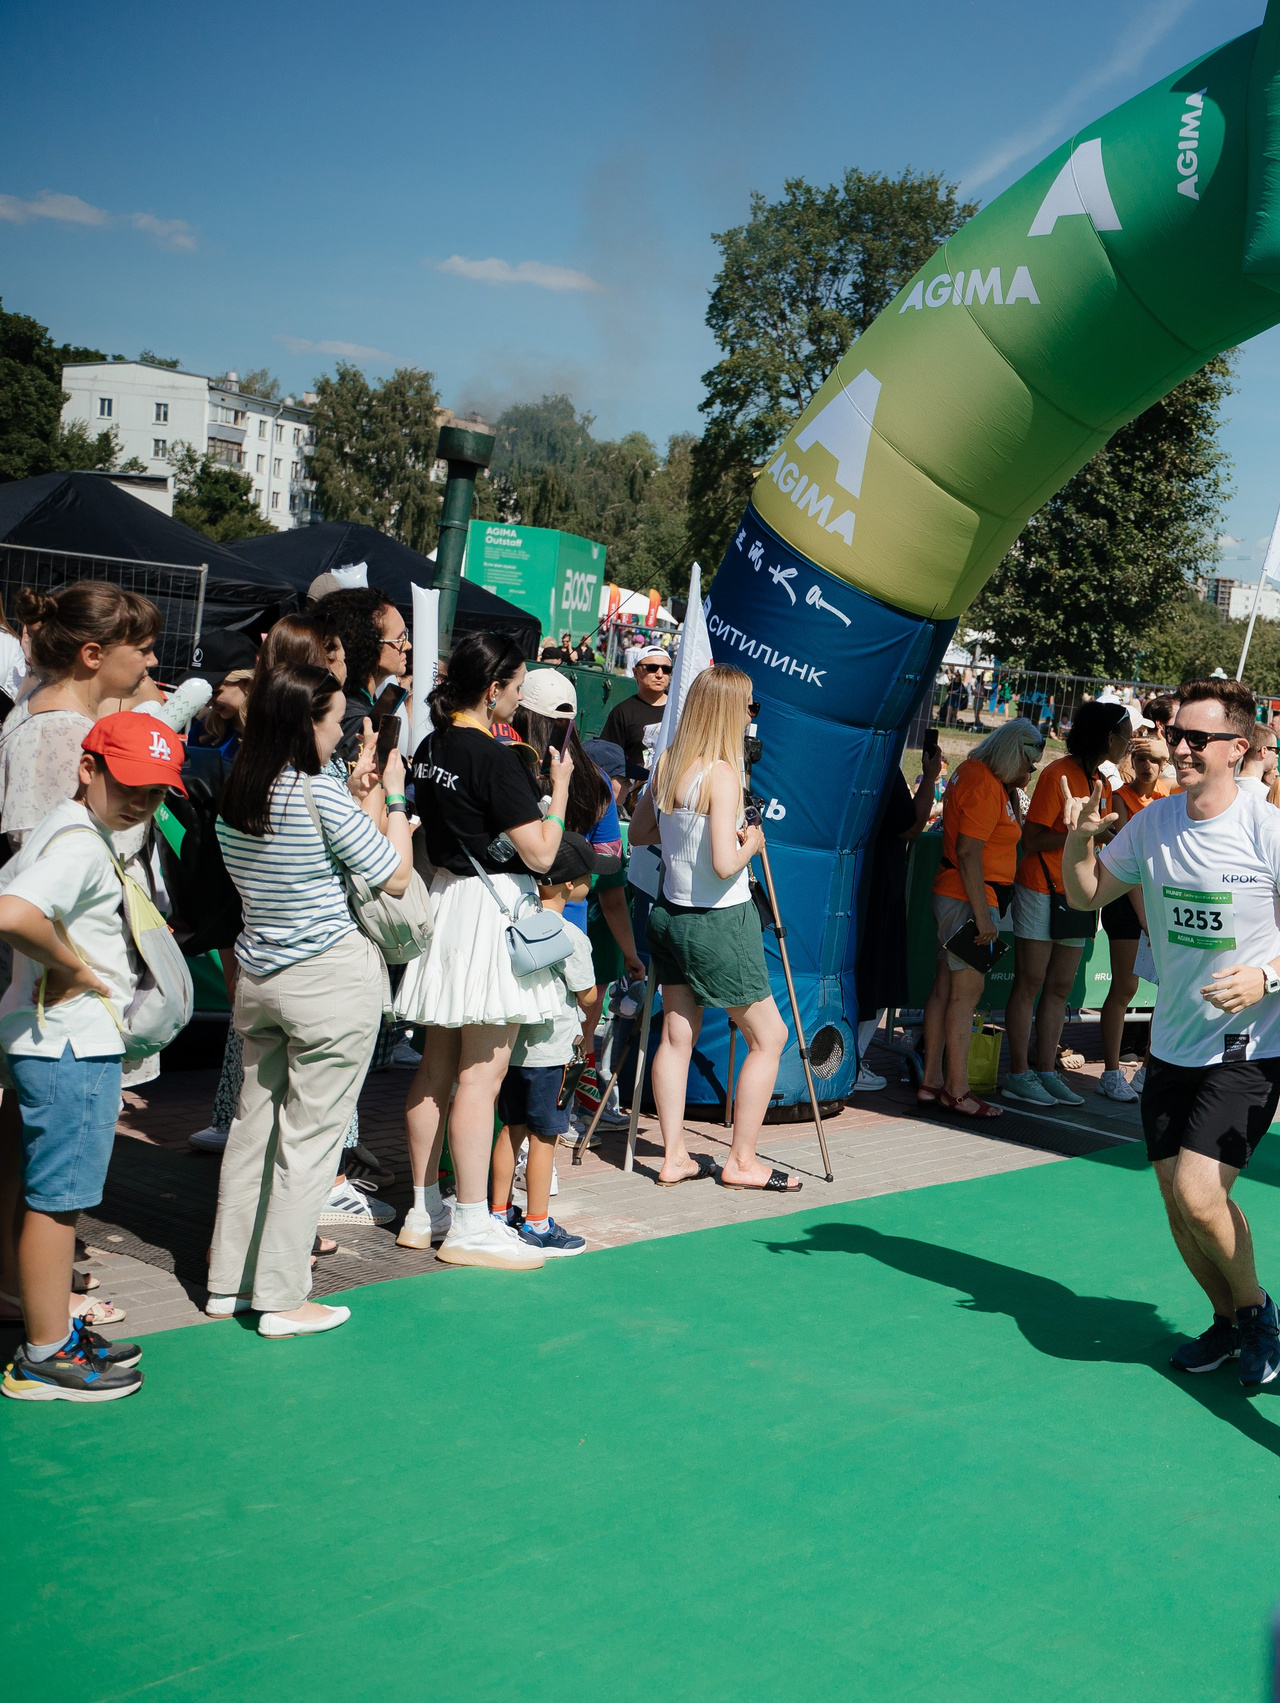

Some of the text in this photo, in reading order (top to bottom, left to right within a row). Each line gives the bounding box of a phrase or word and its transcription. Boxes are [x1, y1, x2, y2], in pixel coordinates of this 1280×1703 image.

[1176, 87, 1208, 201] AGIMA
[899, 266, 1041, 313] AGIMA
[767, 451, 856, 546] AGIMA
[485, 536, 522, 547] Outstaff
[486, 527, 517, 538] AGIMA
[709, 615, 827, 687] СИТИЛИНК
[149, 731, 171, 761] LA
[1222, 874, 1258, 883] КРОК
[1173, 907, 1223, 931] 1253
